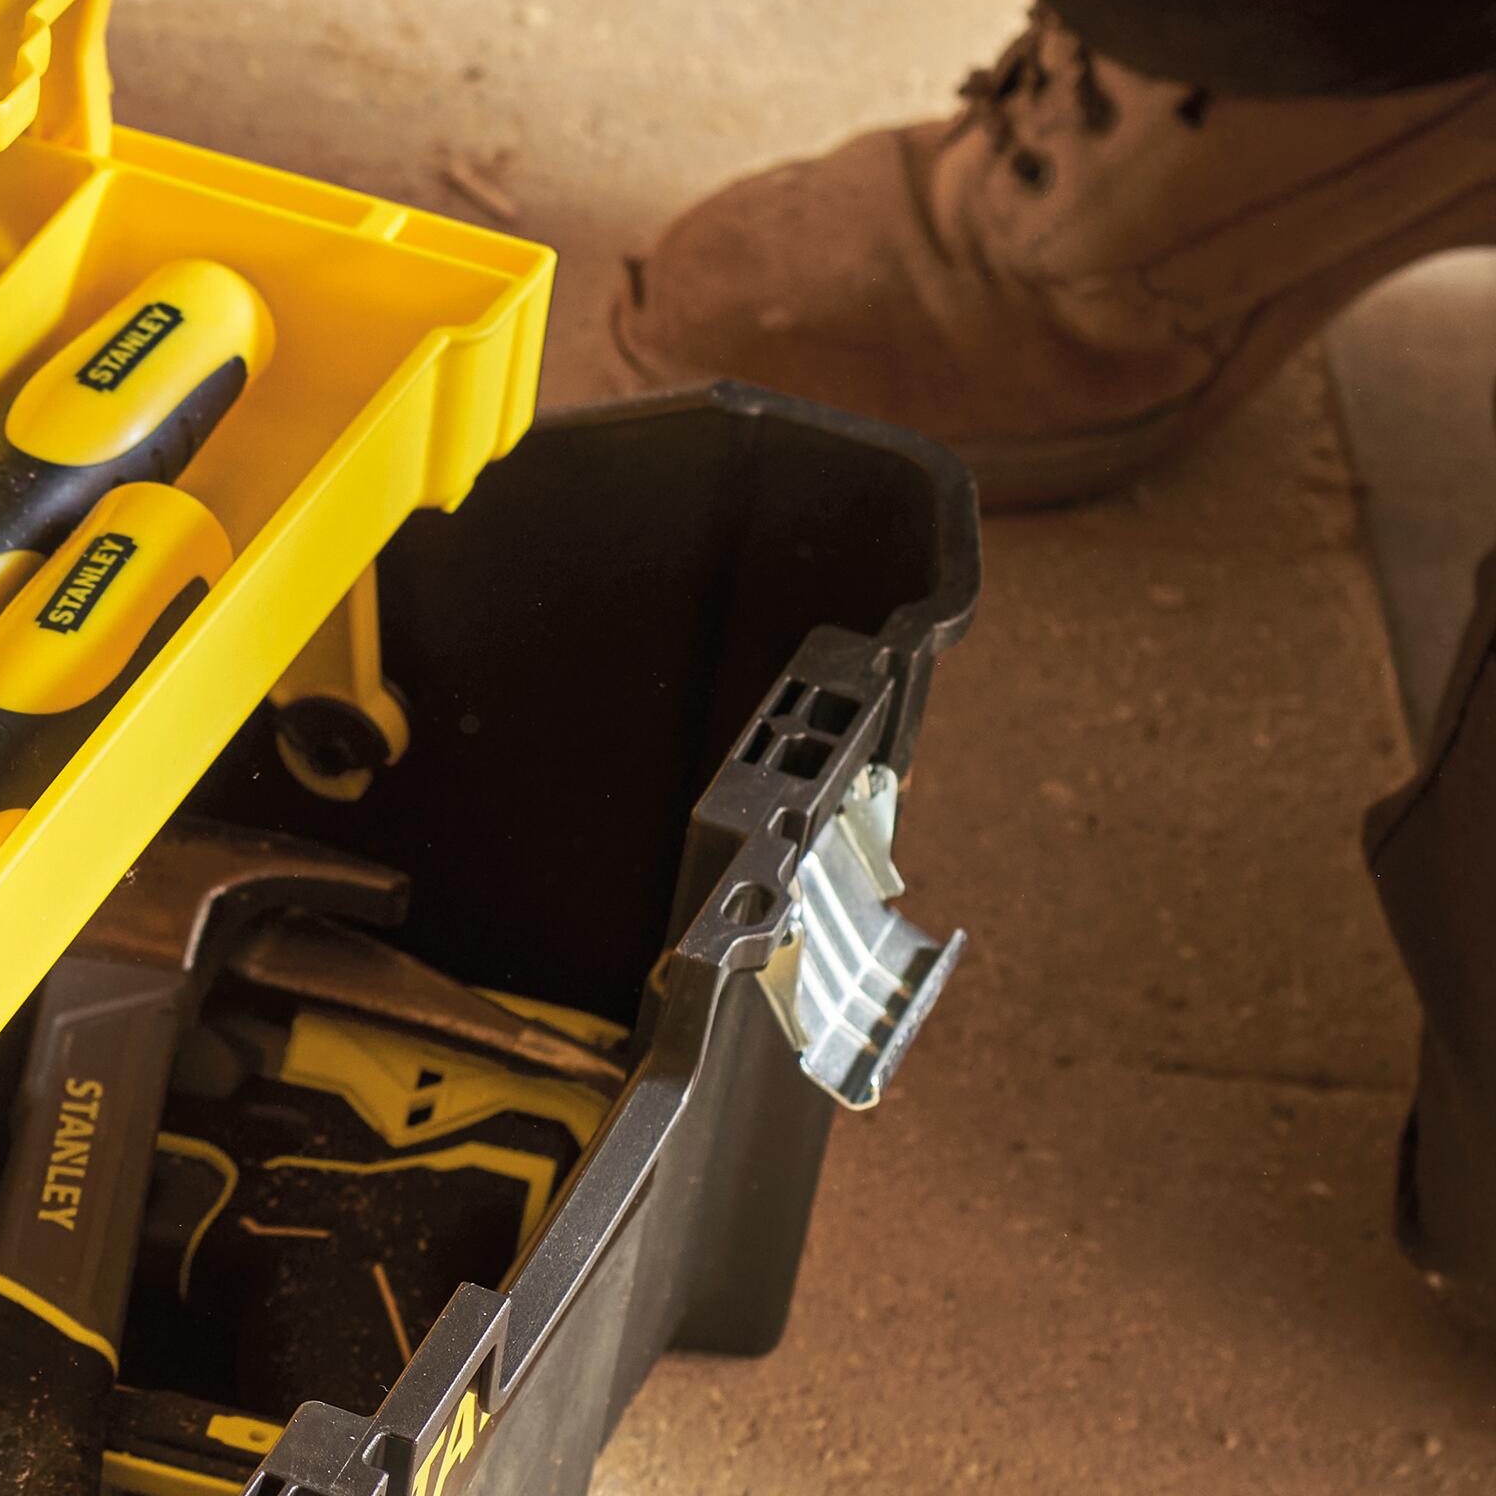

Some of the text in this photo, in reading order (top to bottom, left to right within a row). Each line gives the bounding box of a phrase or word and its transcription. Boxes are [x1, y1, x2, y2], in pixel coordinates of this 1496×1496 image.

[88, 306, 173, 385] STANLEY
[47, 538, 125, 626] STANLEY
[37, 1076, 104, 1232] STANLEY
